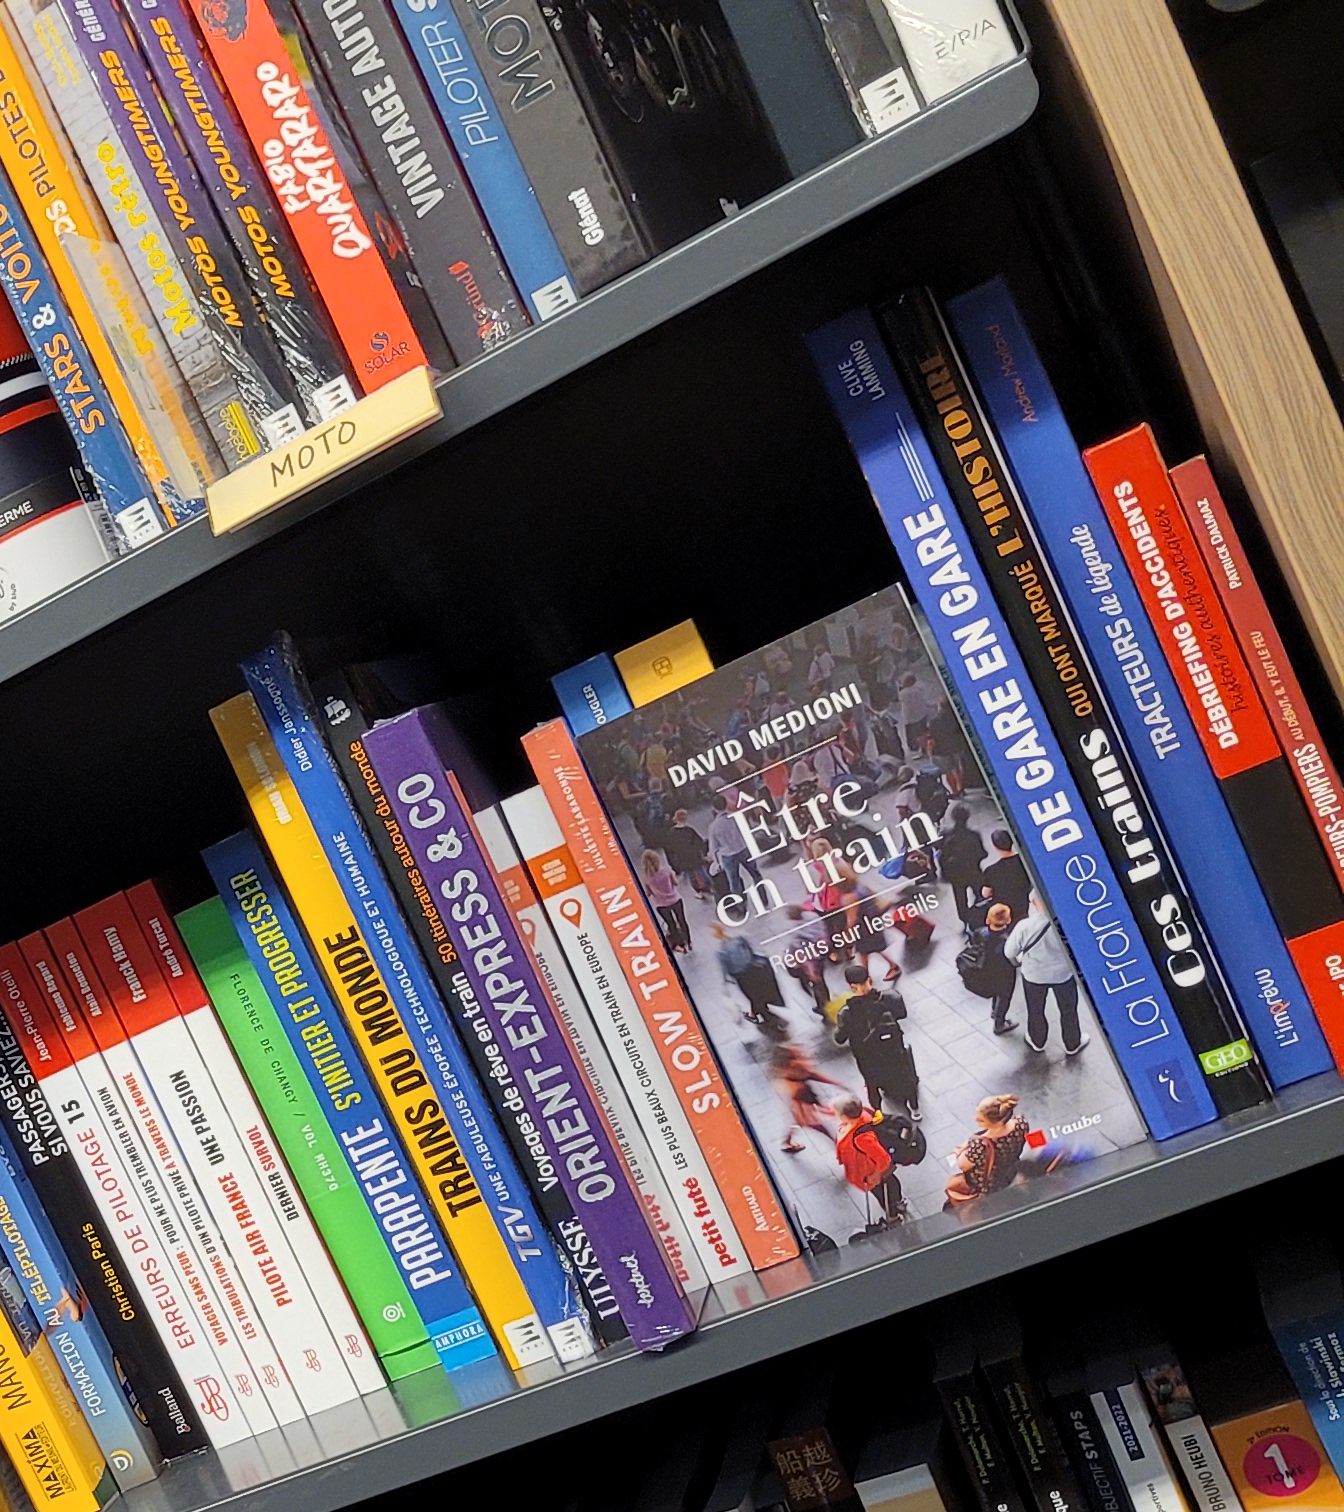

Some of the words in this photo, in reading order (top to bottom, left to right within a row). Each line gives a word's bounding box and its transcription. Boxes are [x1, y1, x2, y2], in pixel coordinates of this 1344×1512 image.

[933, 18, 1000, 61] E/P/A
[97, 143, 147, 227] rétro
[99, 49, 200, 231] YOUNGTIMERS
[256, 61, 373, 259] QUARTARARO
[262, 138, 313, 213] FABIO
[565, 186, 605, 248] Glénat
[31, 304, 56, 329] &
[139, 237, 198, 336] Motos
[187, 236, 245, 328] MOTOS
[44, 333, 105, 434] STARS
[364, 341, 412, 375] SOLAR
[270, 421, 357, 489] MOTO
[902, 504, 980, 619] GARE
[1113, 480, 1185, 626] D'ACCIDENTS
[952, 623, 1010, 682] EN
[1171, 625, 1240, 751] DÉBRIEFING
[666, 738, 744, 789] DAVID
[749, 682, 865, 750] MEDIONI
[980, 682, 1058, 787] GARE
[397, 772, 450, 829] CO
[430, 827, 465, 863] &
[727, 780, 870, 862] Être
[1030, 796, 1085, 853] DE
[1078, 728, 1165, 885] trains
[714, 884, 785, 931] en
[791, 805, 944, 903] train
[605, 884, 662, 1006] TRAIN
[769, 935, 829, 972] Récits
[830, 926, 862, 953] sur
[863, 913, 894, 939] les
[895, 891, 940, 931] rails
[1065, 853, 1147, 995] France
[1150, 893, 1207, 989] Ces
[323, 925, 396, 1047] MONDE
[1127, 1001, 1171, 1049] La
[380, 1044, 429, 1098] DU
[440, 869, 616, 1203] ORIENT-EXPRESS
[653, 1007, 720, 1115] SLOW
[60, 1099, 91, 1125] 15
[405, 1097, 478, 1219] TRAINS
[1048, 1111, 1102, 1141] l'aube
[78, 1128, 135, 1231] PILOTAGE
[341, 1118, 453, 1291] PARAPENTE
[131, 1231, 159, 1276] DE
[151, 1276, 196, 1350] ERREURS
